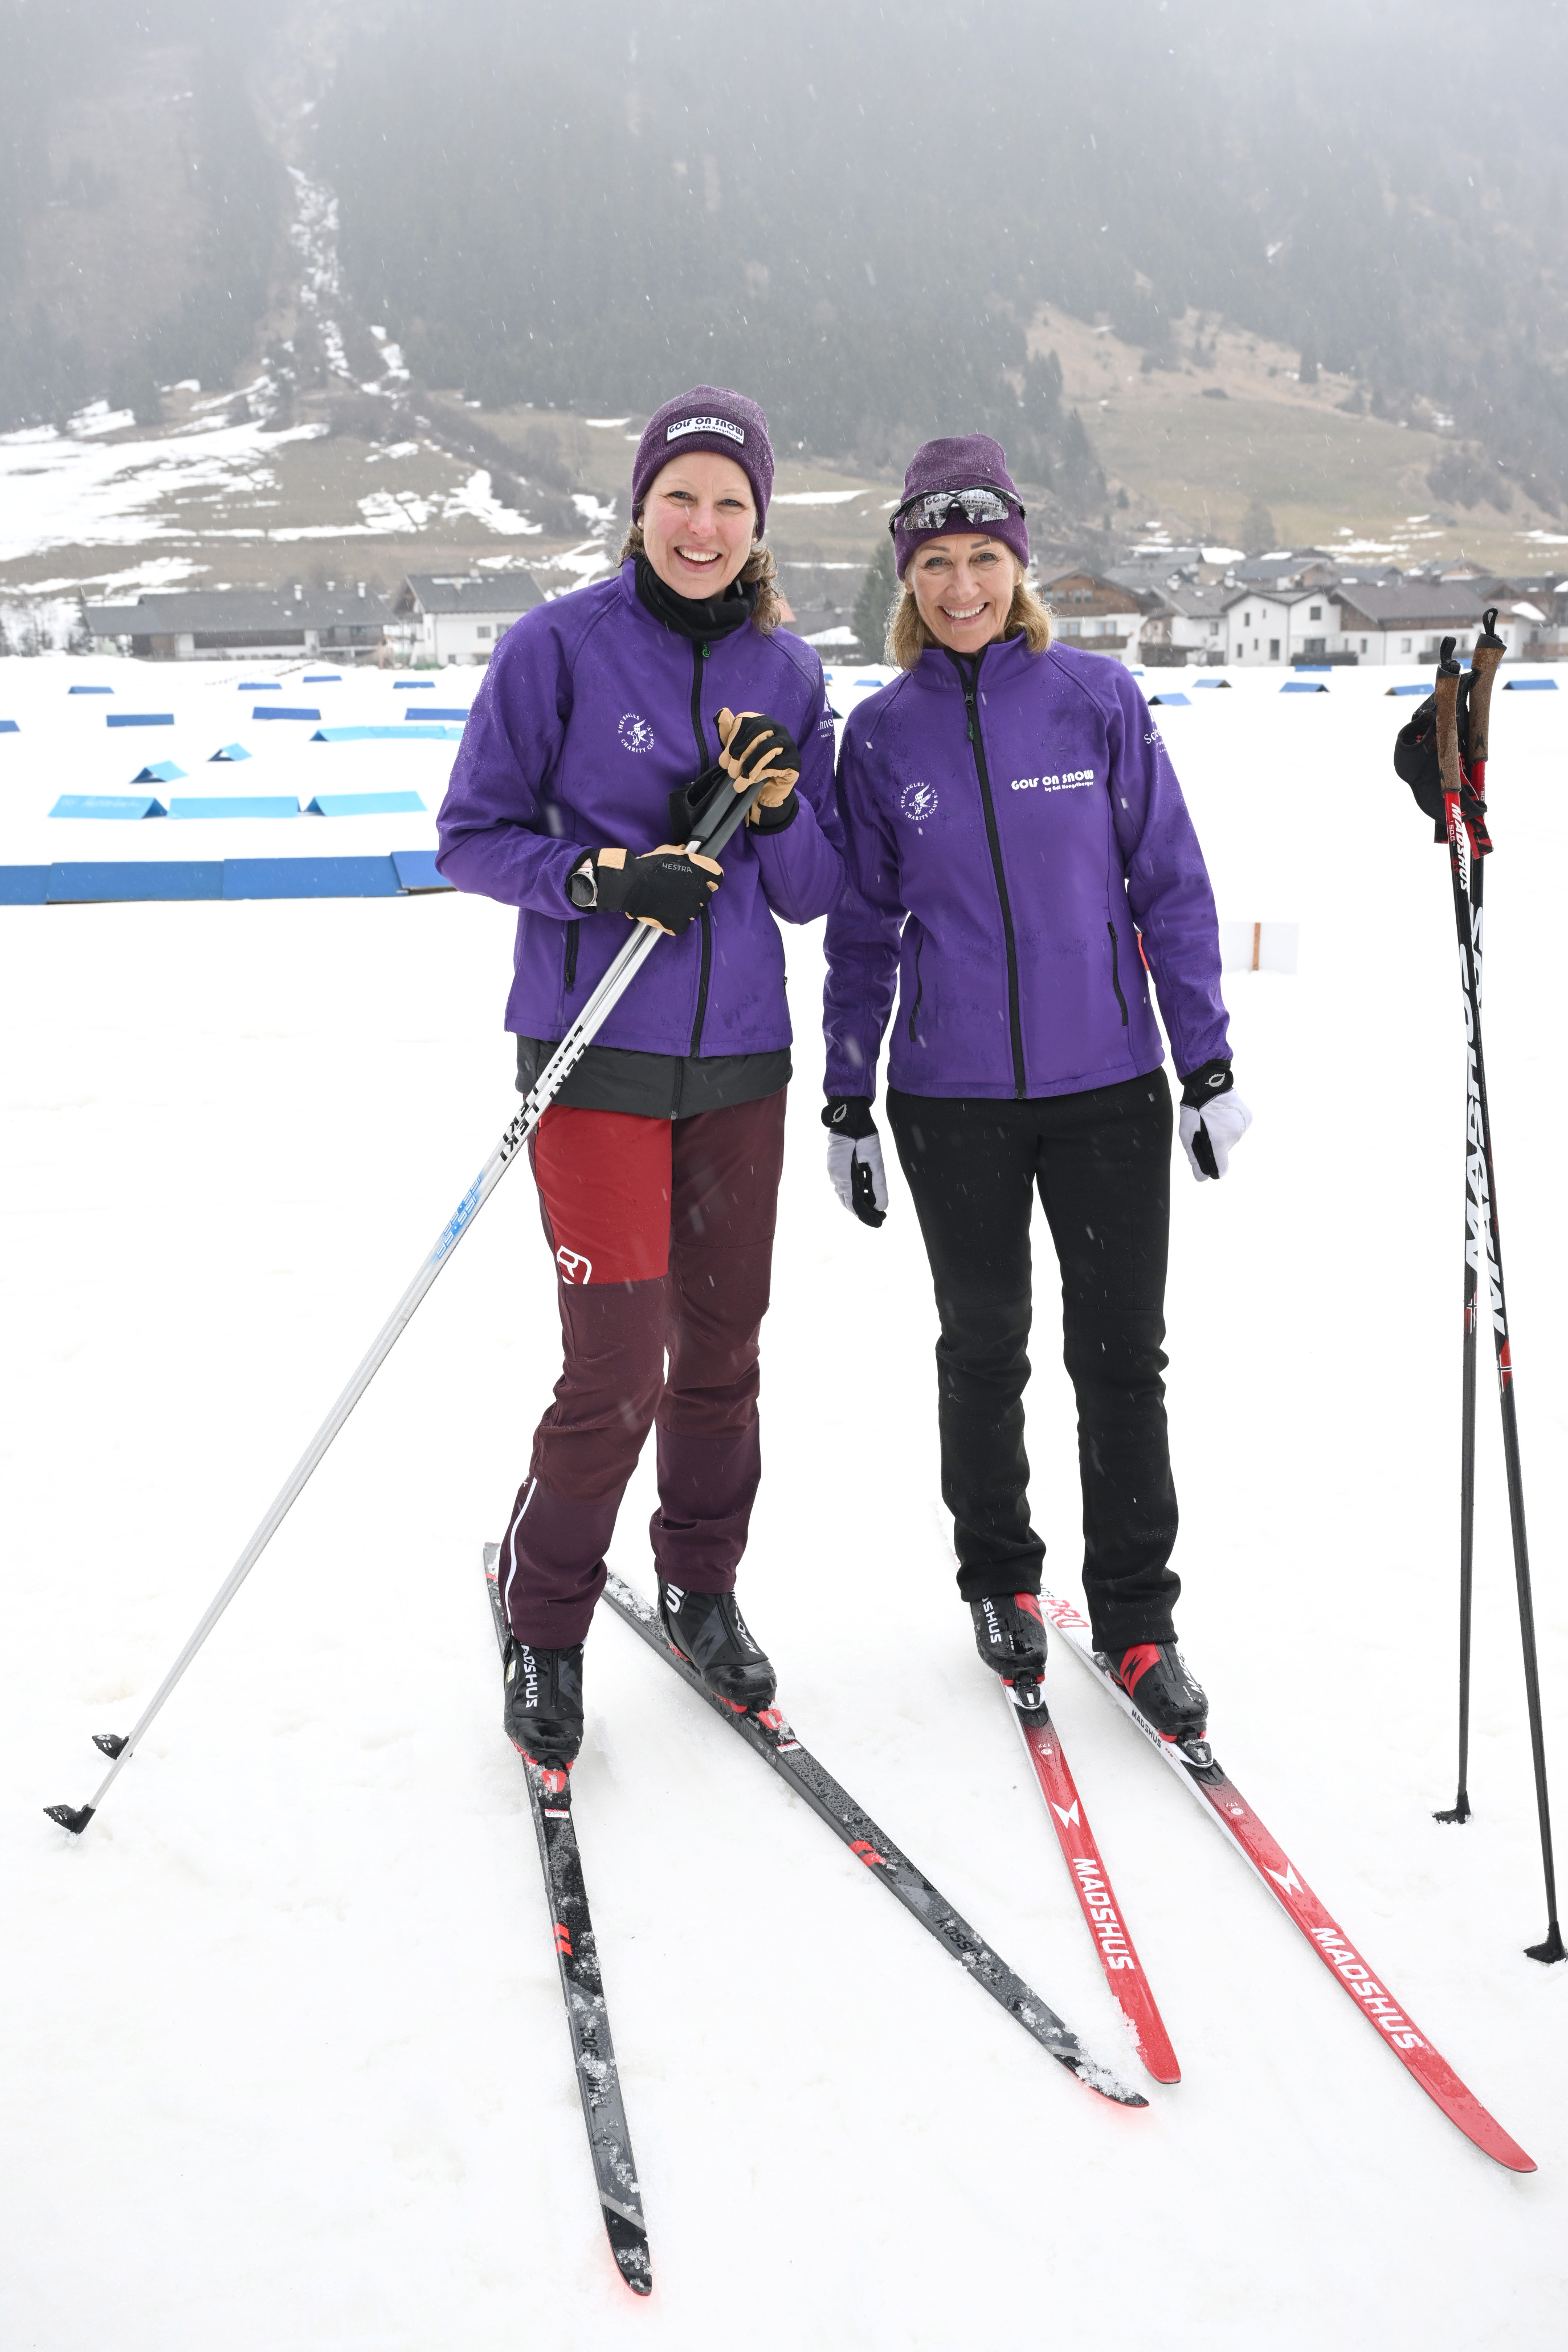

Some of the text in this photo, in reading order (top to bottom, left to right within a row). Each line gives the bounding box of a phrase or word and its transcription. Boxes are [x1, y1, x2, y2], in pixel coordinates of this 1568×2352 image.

[669, 419, 692, 432] GOLF
[715, 419, 743, 436] SNOW
[621, 739, 646, 753] CHARITY
[903, 782, 924, 794] EAGLES
[1011, 770, 1094, 790] GOLF ON SNOW
[929, 801, 938, 814] CLUB
[1451, 803, 1468, 892] MADSHUS
[662, 863, 692, 873] HESTRA
[500, 1102, 540, 1162] LEKI
[1039, 1599, 1091, 1628] PRO
[520, 1642, 538, 1708] ADSHUS
[1132, 1709, 1161, 1748] MADSHUS
[1072, 1858, 1135, 1970] MADSHUS
[1310, 1928, 1425, 2049] MADSHUS
